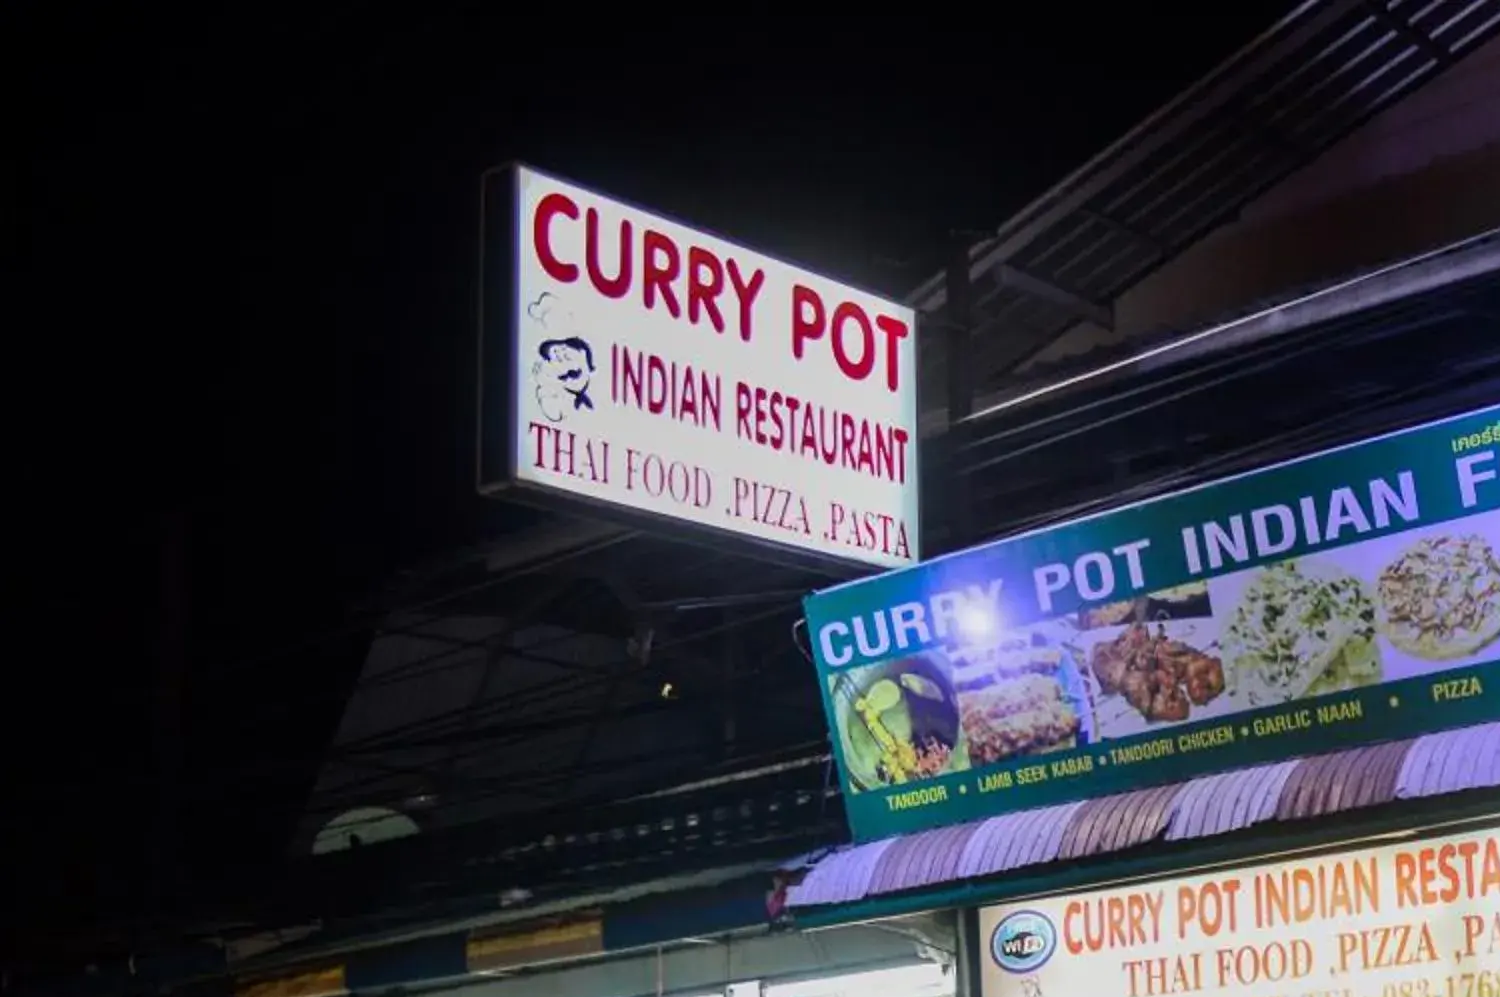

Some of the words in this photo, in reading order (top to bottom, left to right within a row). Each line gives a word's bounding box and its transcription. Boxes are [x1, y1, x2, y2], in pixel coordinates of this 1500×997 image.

[533, 193, 765, 342] CURRY
[792, 284, 909, 392] POT
[529, 422, 609, 485] THAI
[626, 448, 711, 509] FOOD
[611, 343, 721, 432] INDIAN
[736, 382, 908, 484] RESTAURANT
[818, 578, 1003, 667] CURRY
[1033, 539, 1151, 612] POT
[1181, 470, 1419, 574] INDIAN
[885, 785, 947, 811] TANDOOR
[977, 771, 1013, 793] LAMB
[1016, 765, 1048, 784] SEEK
[1051, 755, 1093, 777] KABAB
[1109, 739, 1175, 766] TANDOORI
[1179, 725, 1235, 752] CHICKEN
[1253, 708, 1311, 737] GARLIC
[1317, 699, 1363, 725] NAAN
[1431, 677, 1483, 702] PIZZA
[1063, 890, 1165, 956] CURRY
[1178, 878, 1241, 940] POT
[1254, 855, 1379, 929] INDIAN
[1122, 952, 1203, 997] THAI
[1216, 938, 1313, 988] FOOD
